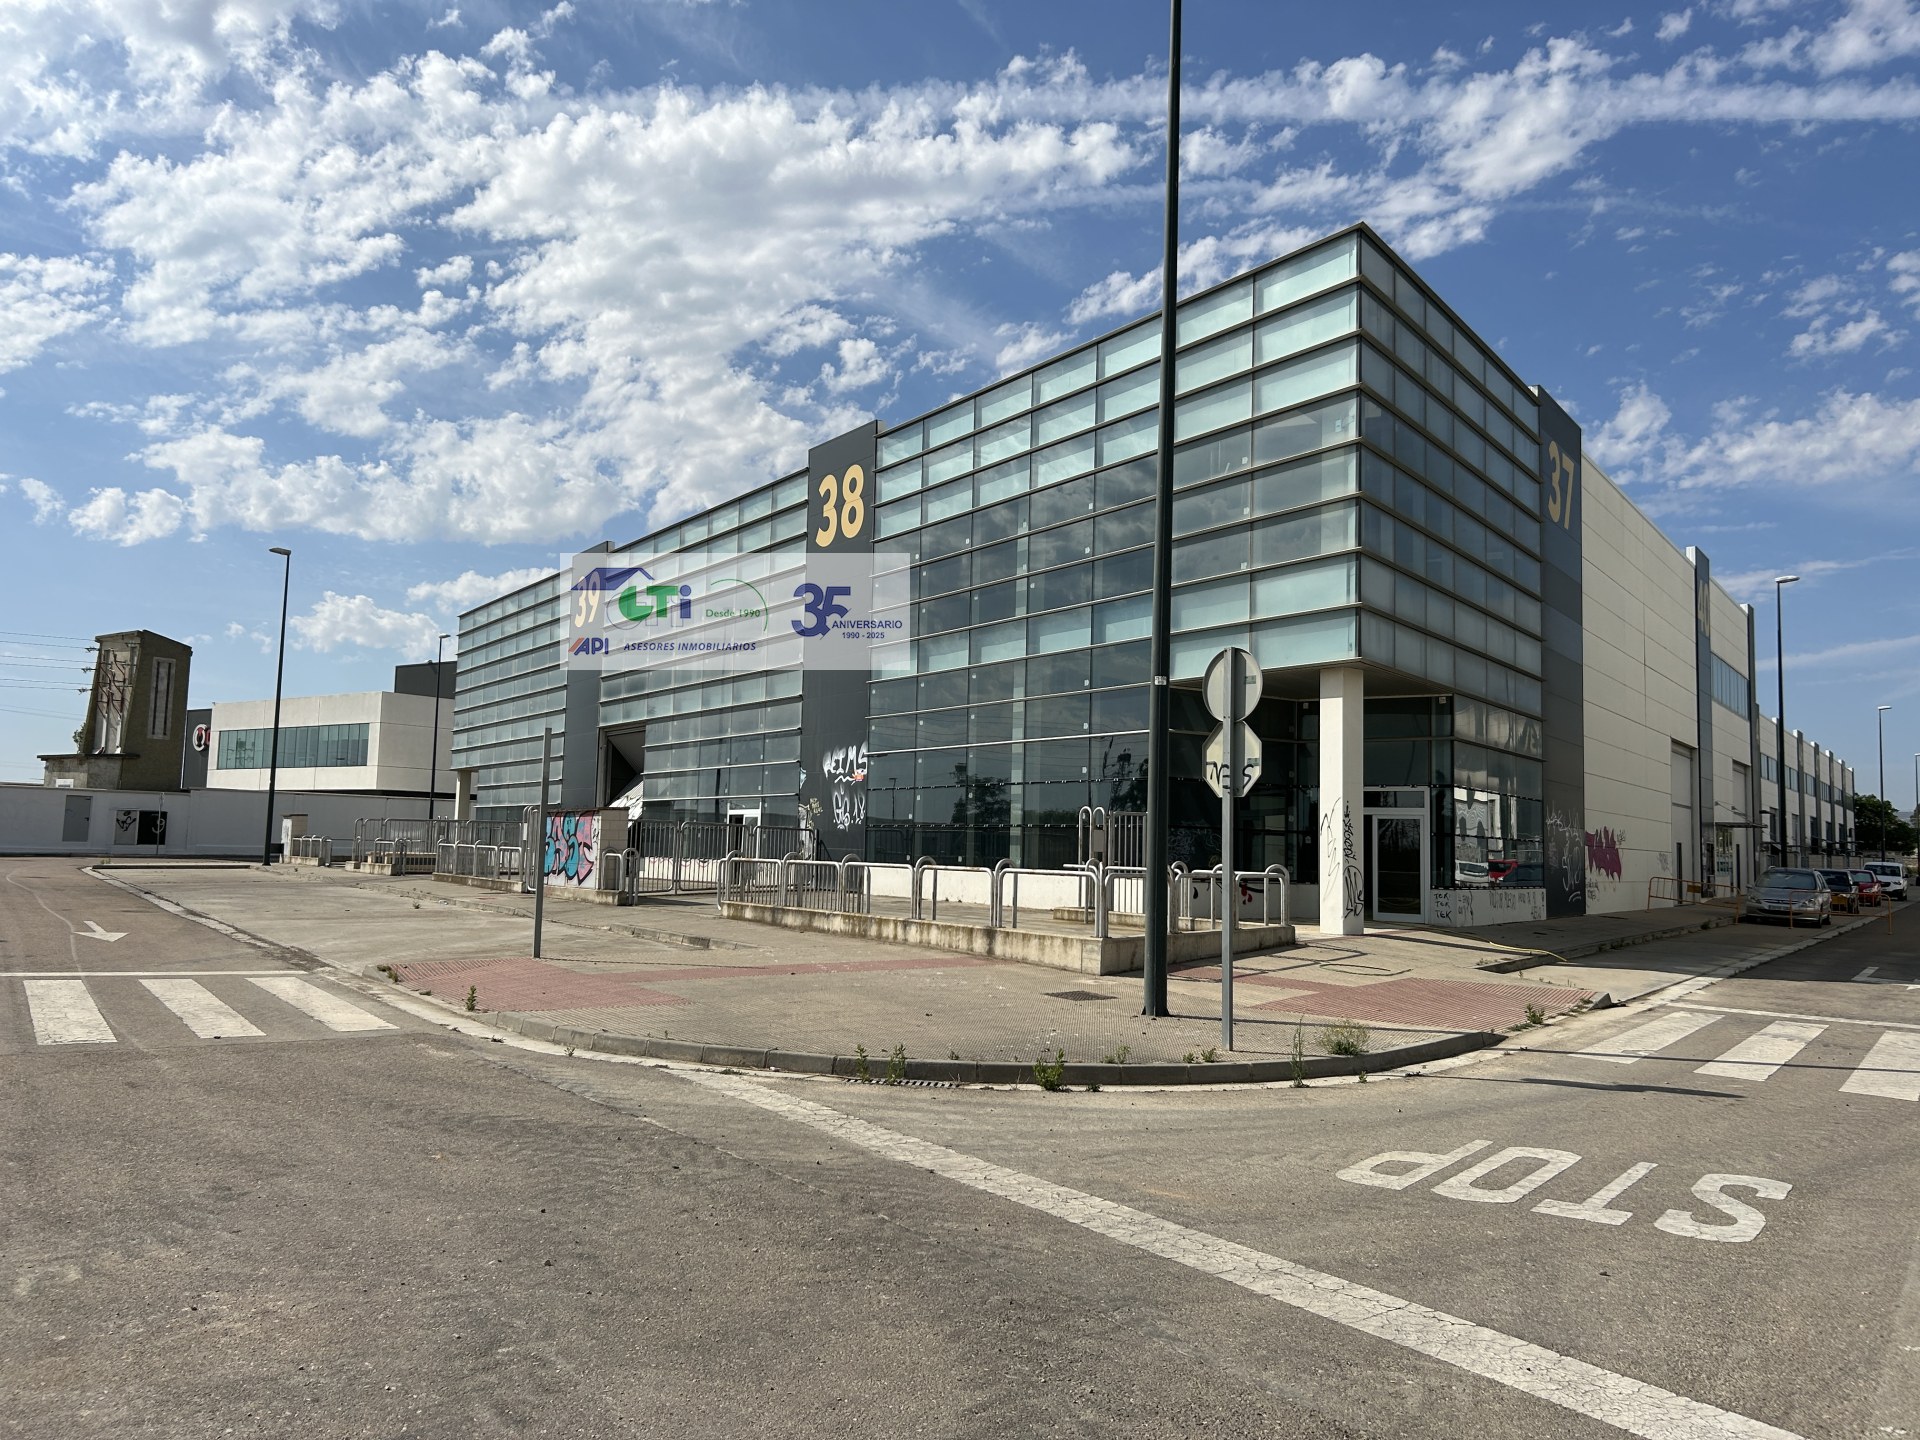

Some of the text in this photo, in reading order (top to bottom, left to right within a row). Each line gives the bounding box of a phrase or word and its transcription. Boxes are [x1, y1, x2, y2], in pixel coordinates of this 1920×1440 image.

[815, 464, 865, 547] 38
[1548, 440, 1575, 530] 37
[574, 571, 601, 628] 39
[1335, 1140, 1794, 1243] STOP
